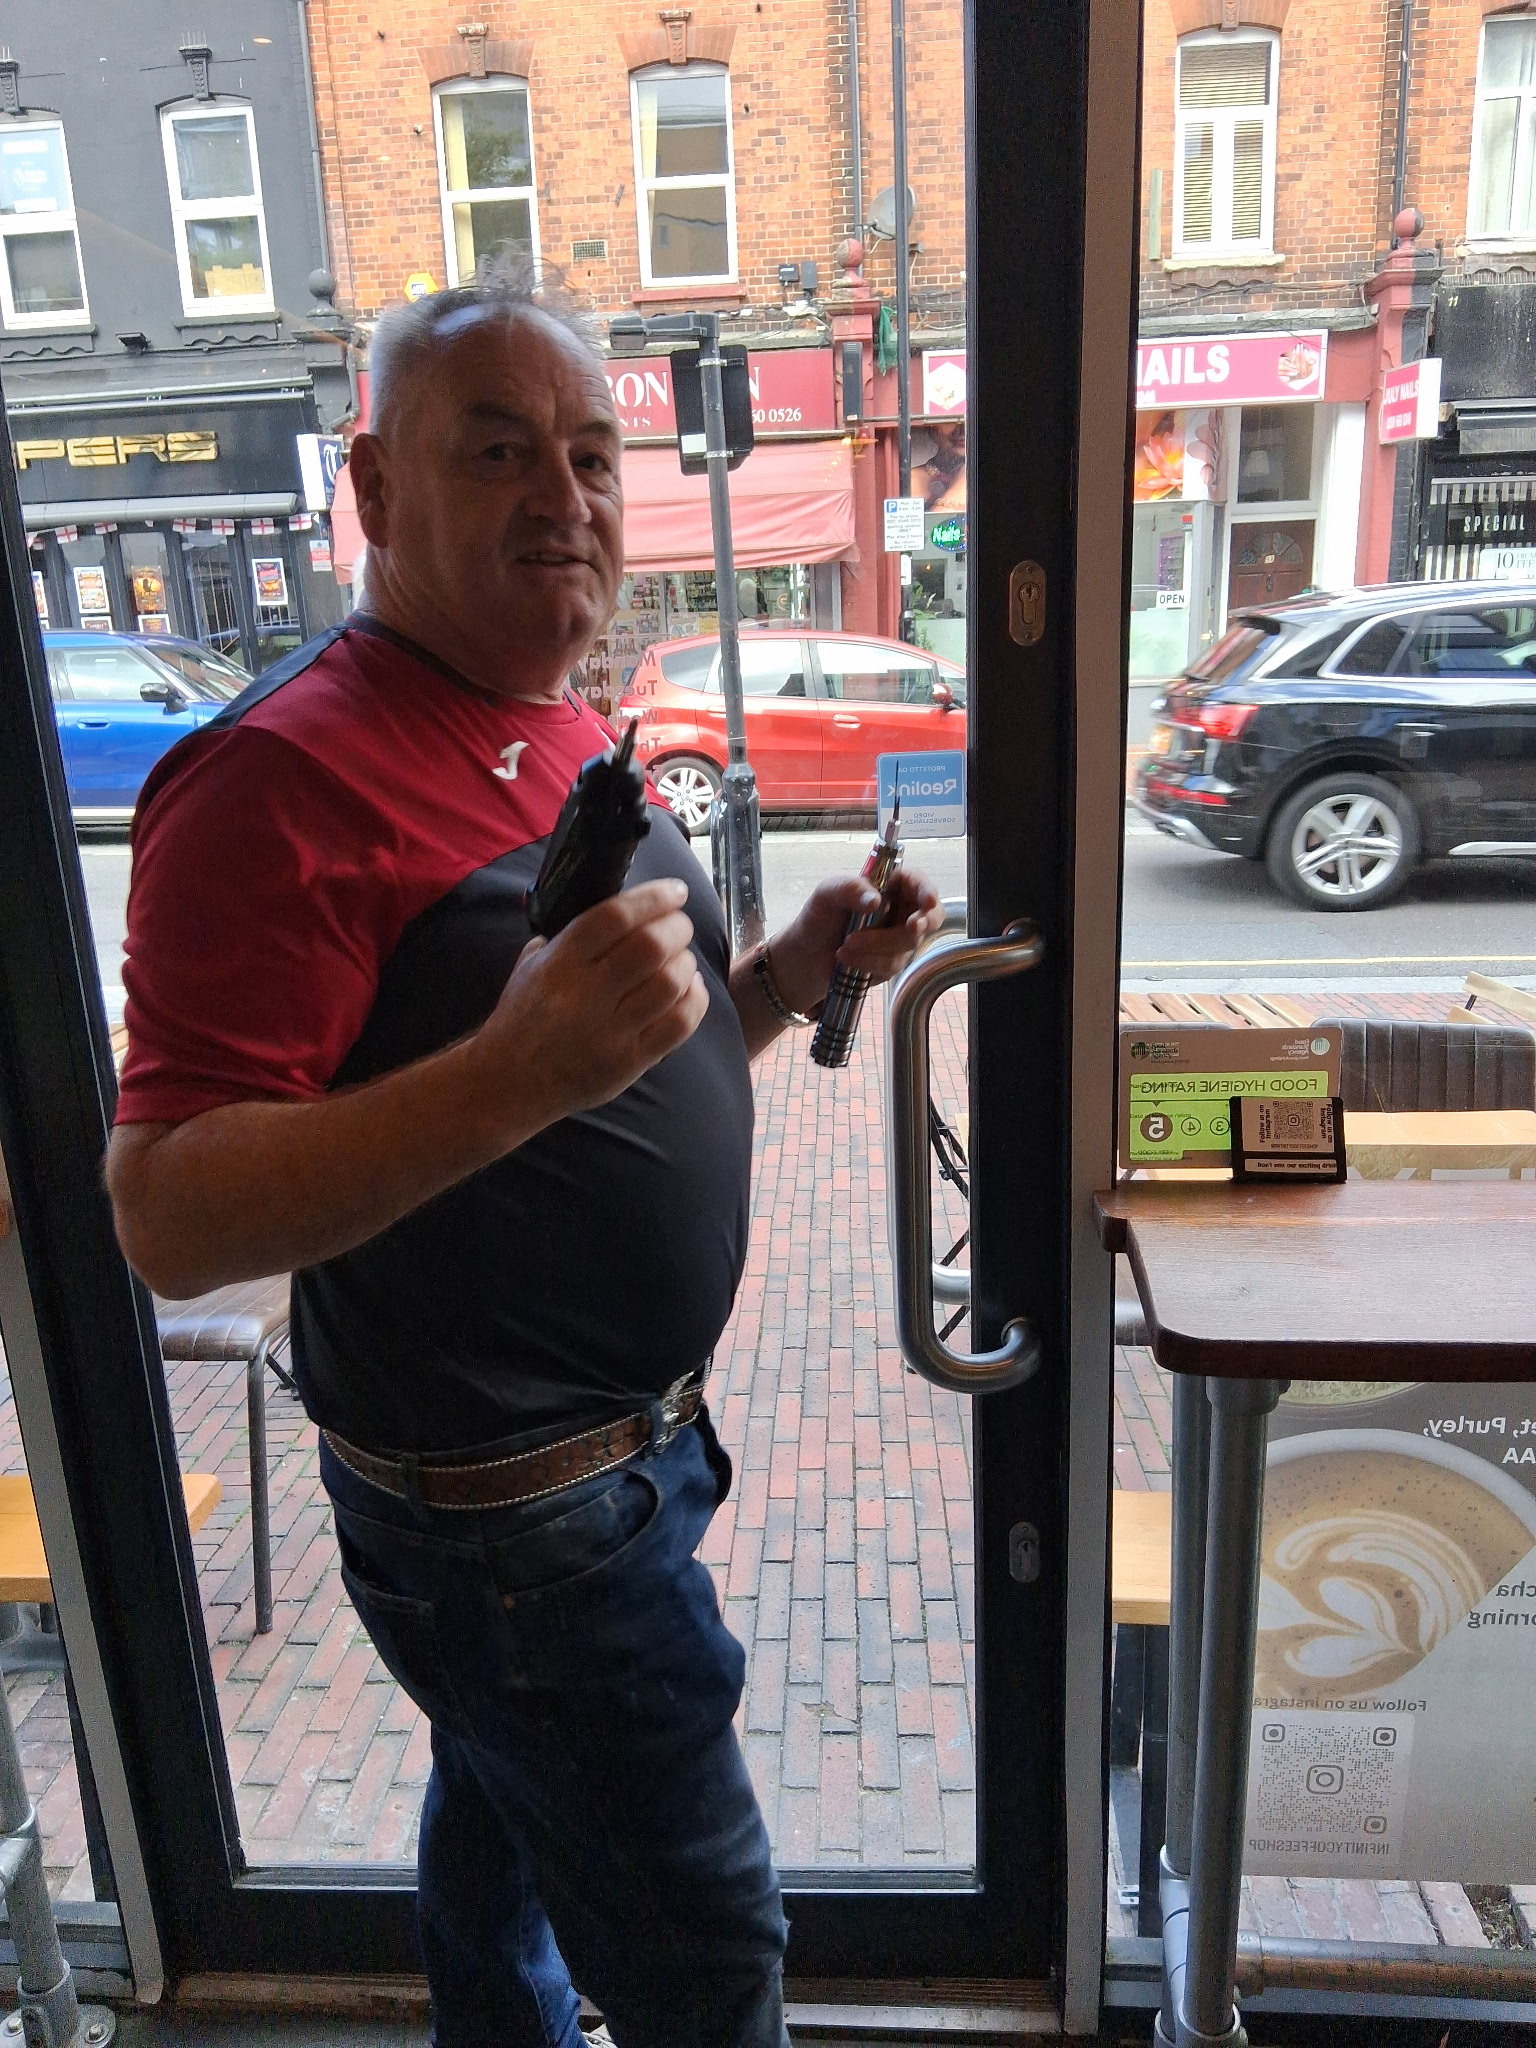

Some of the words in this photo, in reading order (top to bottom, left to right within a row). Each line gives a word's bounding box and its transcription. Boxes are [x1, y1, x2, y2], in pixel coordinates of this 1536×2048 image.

[768, 408, 802, 423] 0526
[1464, 514, 1524, 532] SPECIAL
[932, 525, 961, 543] Nails
[1160, 594, 1184, 604] OPEN
